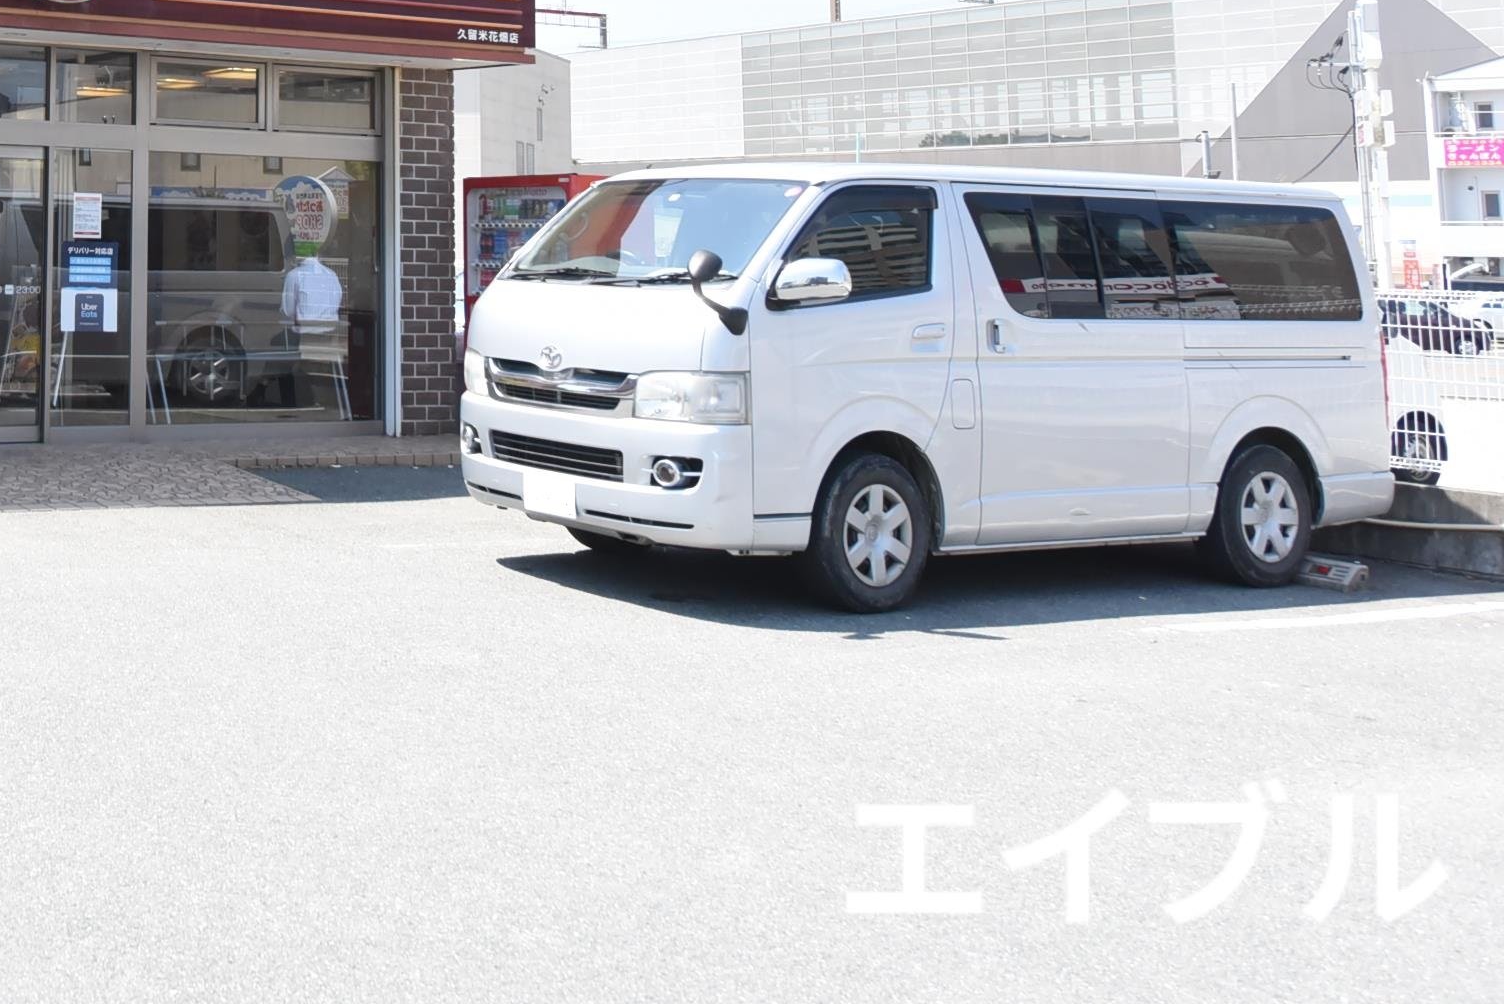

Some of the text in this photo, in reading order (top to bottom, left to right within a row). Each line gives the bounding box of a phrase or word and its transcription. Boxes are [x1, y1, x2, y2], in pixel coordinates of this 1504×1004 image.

[457, 28, 519, 44] 久留米花畑店
[67, 245, 114, 256] デリバリー対応店
[80, 302, 98, 311] Uber
[80, 310, 98, 318] Eats
